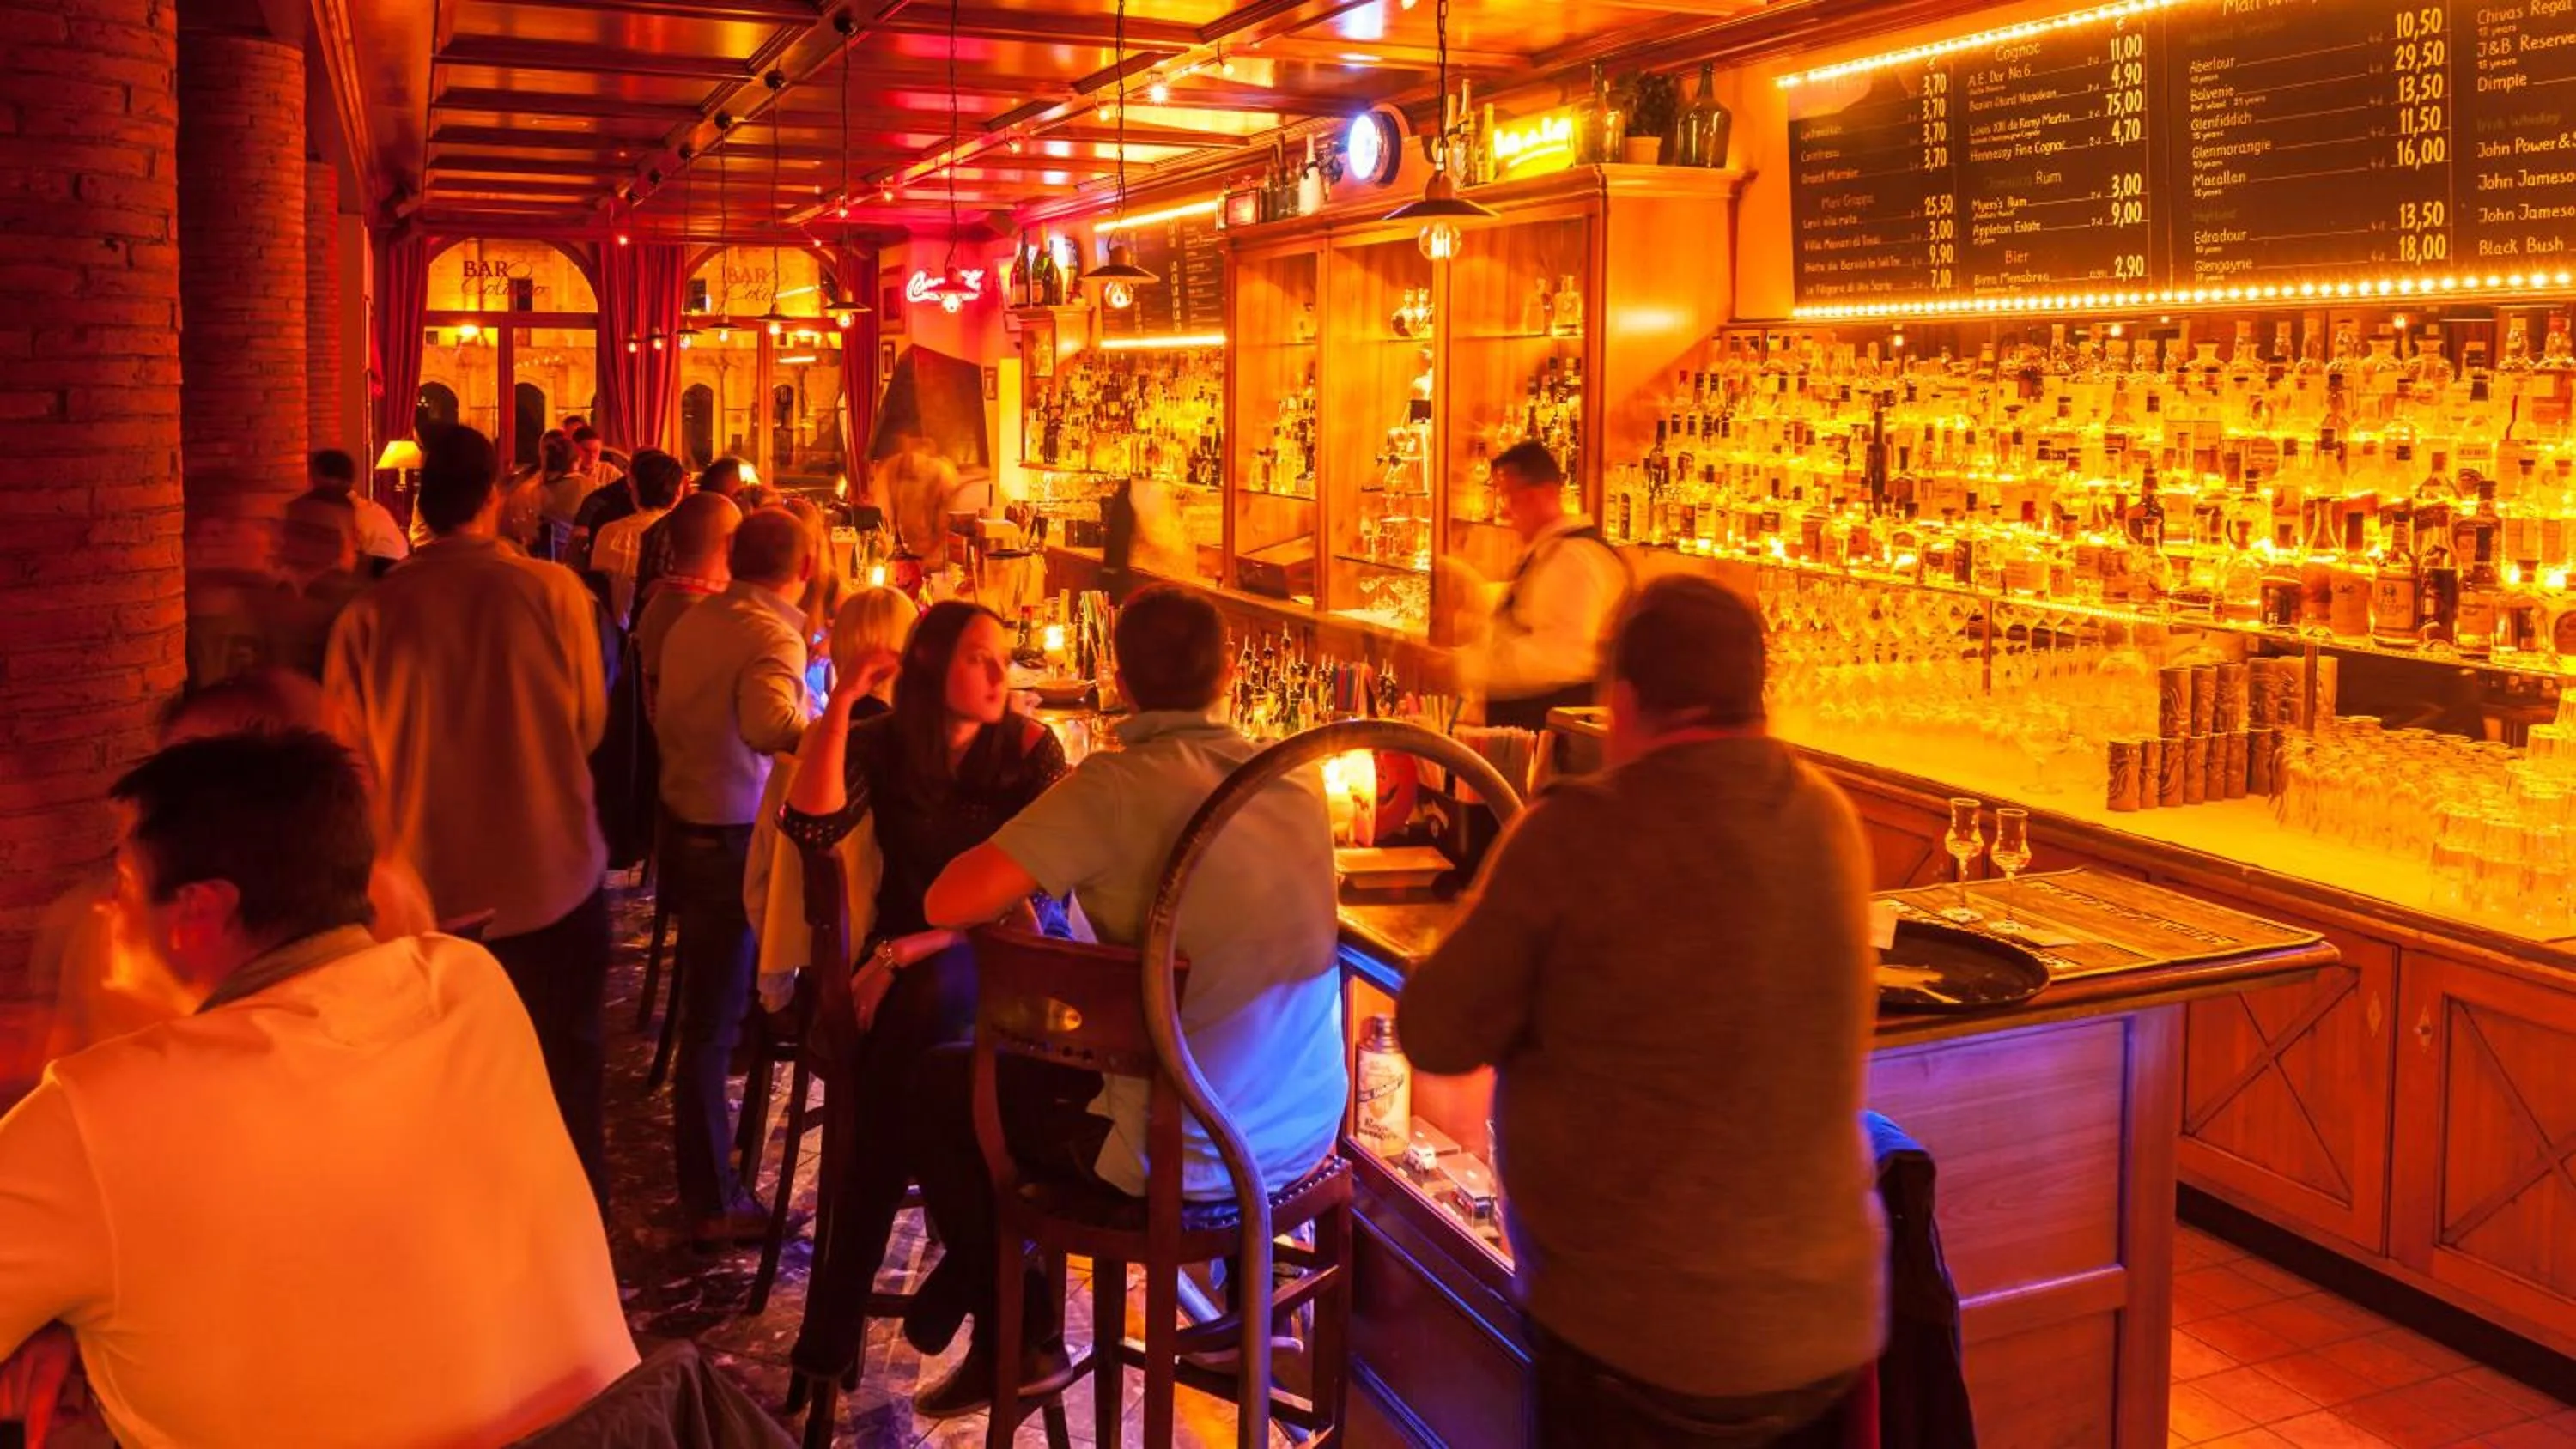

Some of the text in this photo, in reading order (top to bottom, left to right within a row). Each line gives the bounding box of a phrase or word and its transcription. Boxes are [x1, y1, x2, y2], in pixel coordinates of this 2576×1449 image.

[2396, 7, 2443, 42] 10,50
[2477, 0, 2573, 25] Chivas Regal
[1995, 43, 2042, 62] Cognac
[2111, 33, 2143, 64] 11,00
[2520, 33, 2576, 52] Reserve
[2189, 56, 2236, 75] Aberlour
[2394, 39, 2445, 74] 29,50
[1923, 73, 1947, 98] 3,70
[2111, 62, 2142, 89] 4,90
[2477, 73, 2527, 94] Dimple
[2190, 85, 2234, 101] Balvenie
[2398, 73, 2443, 106] 13,50
[1923, 97, 1946, 122] 3,70
[2106, 89, 2142, 118] 75,00
[1969, 124, 1991, 136] Louis
[2042, 111, 2070, 125] Martin
[2111, 118, 2141, 146] 4,70
[2190, 111, 2252, 131] Glenfiddich
[2400, 106, 2441, 138] 11,50
[1923, 122, 1947, 145] 3,70
[2192, 139, 2271, 159] Glenmorangie
[2397, 136, 2445, 171] 16,00
[2477, 139, 2511, 158] John
[2515, 136, 2556, 155] Power
[1924, 147, 1947, 172] 3,70
[2036, 171, 2062, 184] Rum
[2111, 173, 2142, 200] 3,00
[2193, 170, 2246, 187] Macallan
[2477, 169, 2576, 191] John Jameso
[1924, 194, 1953, 218] 25,50
[2111, 201, 2142, 227] 9,00
[2399, 201, 2445, 233] 13,50
[2478, 203, 2576, 223] John Jameso
[1929, 220, 1953, 244] 3,00
[1973, 221, 2041, 239] Appleton Estate
[2194, 227, 2248, 245] Edradour
[1929, 244, 1953, 268] 9,90
[2005, 250, 2029, 264] Bier
[2399, 233, 2446, 266] 18,00
[2479, 235, 2563, 256] Black Bush
[464, 260, 508, 277] BAR
[728, 267, 769, 283] BAR
[2115, 254, 2144, 282] 2,90
[2194, 258, 2253, 274] Glengoyne
[1931, 269, 1952, 292] 7,10
